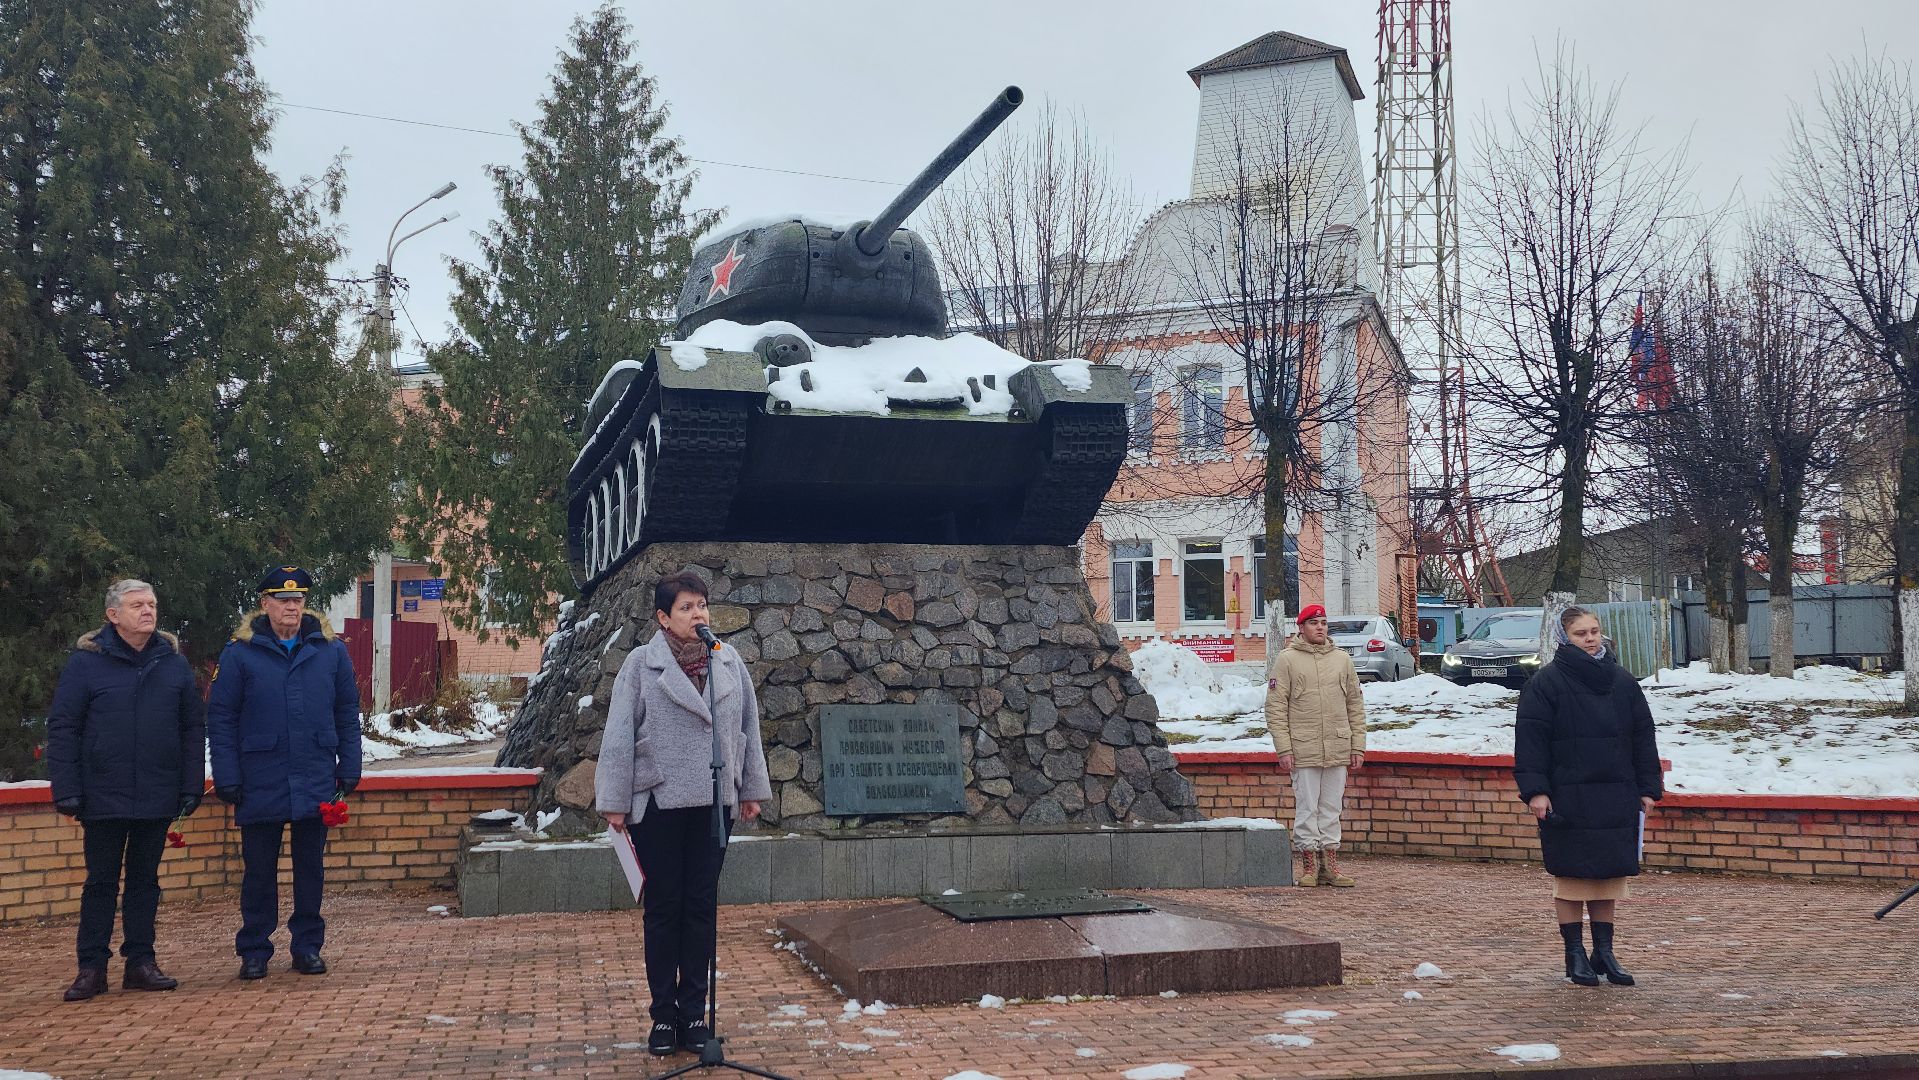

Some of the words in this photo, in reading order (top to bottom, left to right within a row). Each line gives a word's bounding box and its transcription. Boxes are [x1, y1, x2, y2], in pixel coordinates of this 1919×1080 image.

[849, 719, 895, 733] СОВЕТСКИМ
[840, 740, 894, 755] ПРОЯВИВШИМ
[902, 740, 945, 754] МУЖЕСТВО
[830, 763, 845, 777] ПРИ
[850, 762, 883, 777] ЗАЩИТЕ
[886, 762, 893, 777] И
